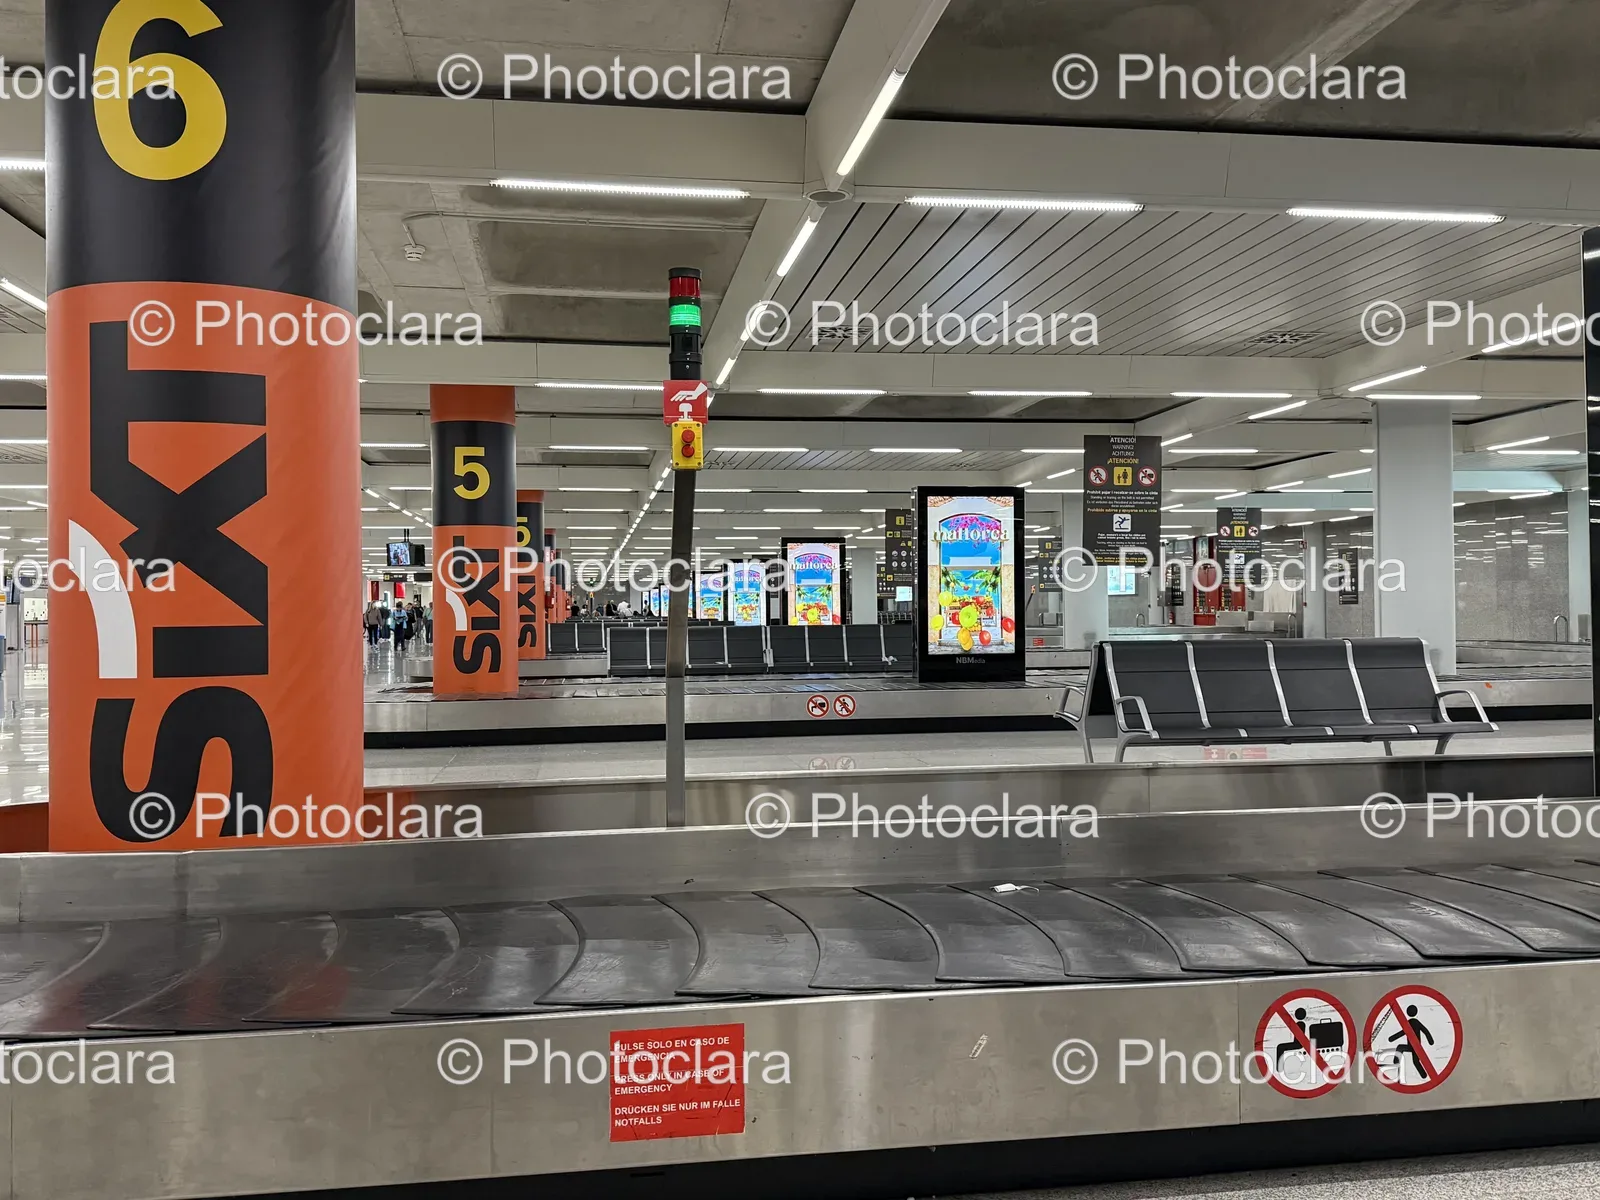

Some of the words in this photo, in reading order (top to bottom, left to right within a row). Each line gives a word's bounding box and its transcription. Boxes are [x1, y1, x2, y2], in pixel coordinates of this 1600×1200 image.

[93, 0, 227, 180] 6
[453, 446, 490, 500] 5
[932, 527, 1009, 542] mallorca
[89, 320, 274, 842] SIXT
[453, 536, 501, 675] SIXT
[614, 1042, 644, 1051] PULSE
[647, 1040, 672, 1049] SOLO
[690, 1038, 715, 1046] CASO
[614, 1052, 676, 1064] EMERGENCIA
[614, 1074, 644, 1083] PRESS
[648, 1073, 672, 1081] ONLY
[685, 1070, 708, 1078] CASE
[614, 1084, 673, 1095] EMERGENCY
[614, 1104, 660, 1116] DRÜCKEN
[679, 1101, 698, 1110] NUR
[700, 1101, 710, 1109] IM
[712, 1099, 740, 1108] FALLE
[614, 1116, 662, 1127] NOTFALLS
